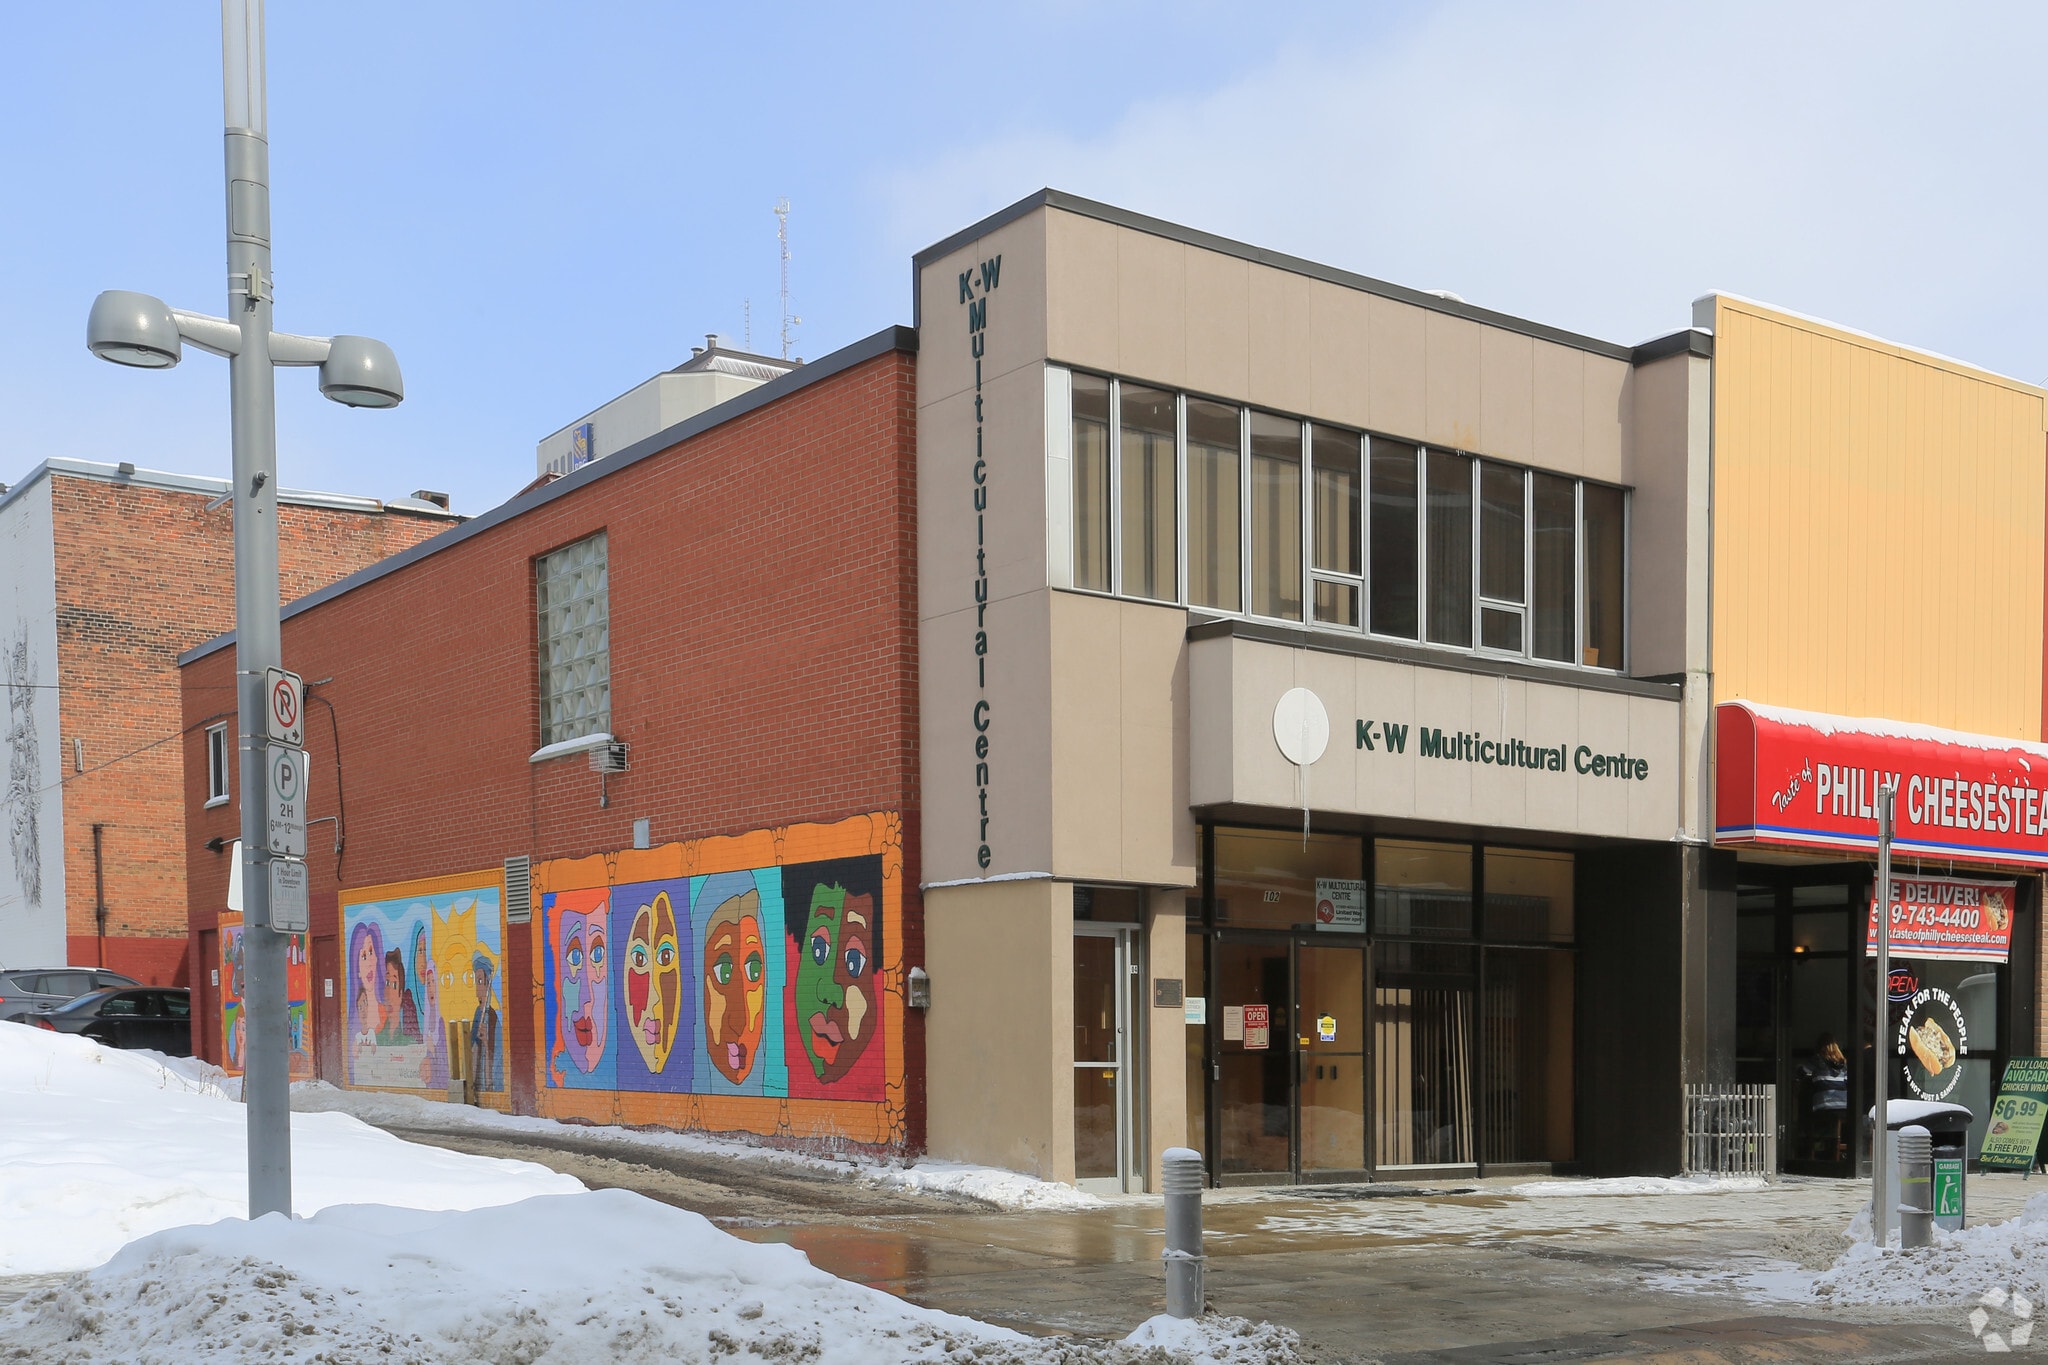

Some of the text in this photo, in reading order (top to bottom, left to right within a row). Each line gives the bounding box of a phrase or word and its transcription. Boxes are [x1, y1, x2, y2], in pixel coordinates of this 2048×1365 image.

[959, 254, 1002, 304] K-W
[969, 296, 988, 688] Multicultural
[1356, 718, 1649, 781] K-W Multicultural Centre
[973, 700, 991, 869] Centre
[1771, 757, 1813, 814] Taste of
[1816, 762, 1901, 822] PHILLY
[1264, 891, 1280, 902] 102
[1328, 882, 1366, 892] MULTICULTURAL
[1331, 892, 1351, 901] CENTRE
[1875, 881, 1980, 907] E DELIVER!
[1871, 902, 1980, 929] 59-743-4400
[1869, 927, 2007, 945] w.tasteofphillycheesesteak.com
[1247, 1011, 1266, 1021] OPEN
[1898, 987, 1968, 1055] STEAK FOR THE PEOPLE
[2009, 1060, 2048, 1070] FULLY LOAD
[1903, 1064, 1963, 1102] IT'S NOT JUST A SANDWICH
[2001, 1082, 2029, 1092] CHICKEN
[1995, 1098, 2038, 1121] $6.99
[1987, 1144, 2030, 1154] A FREE POP!
